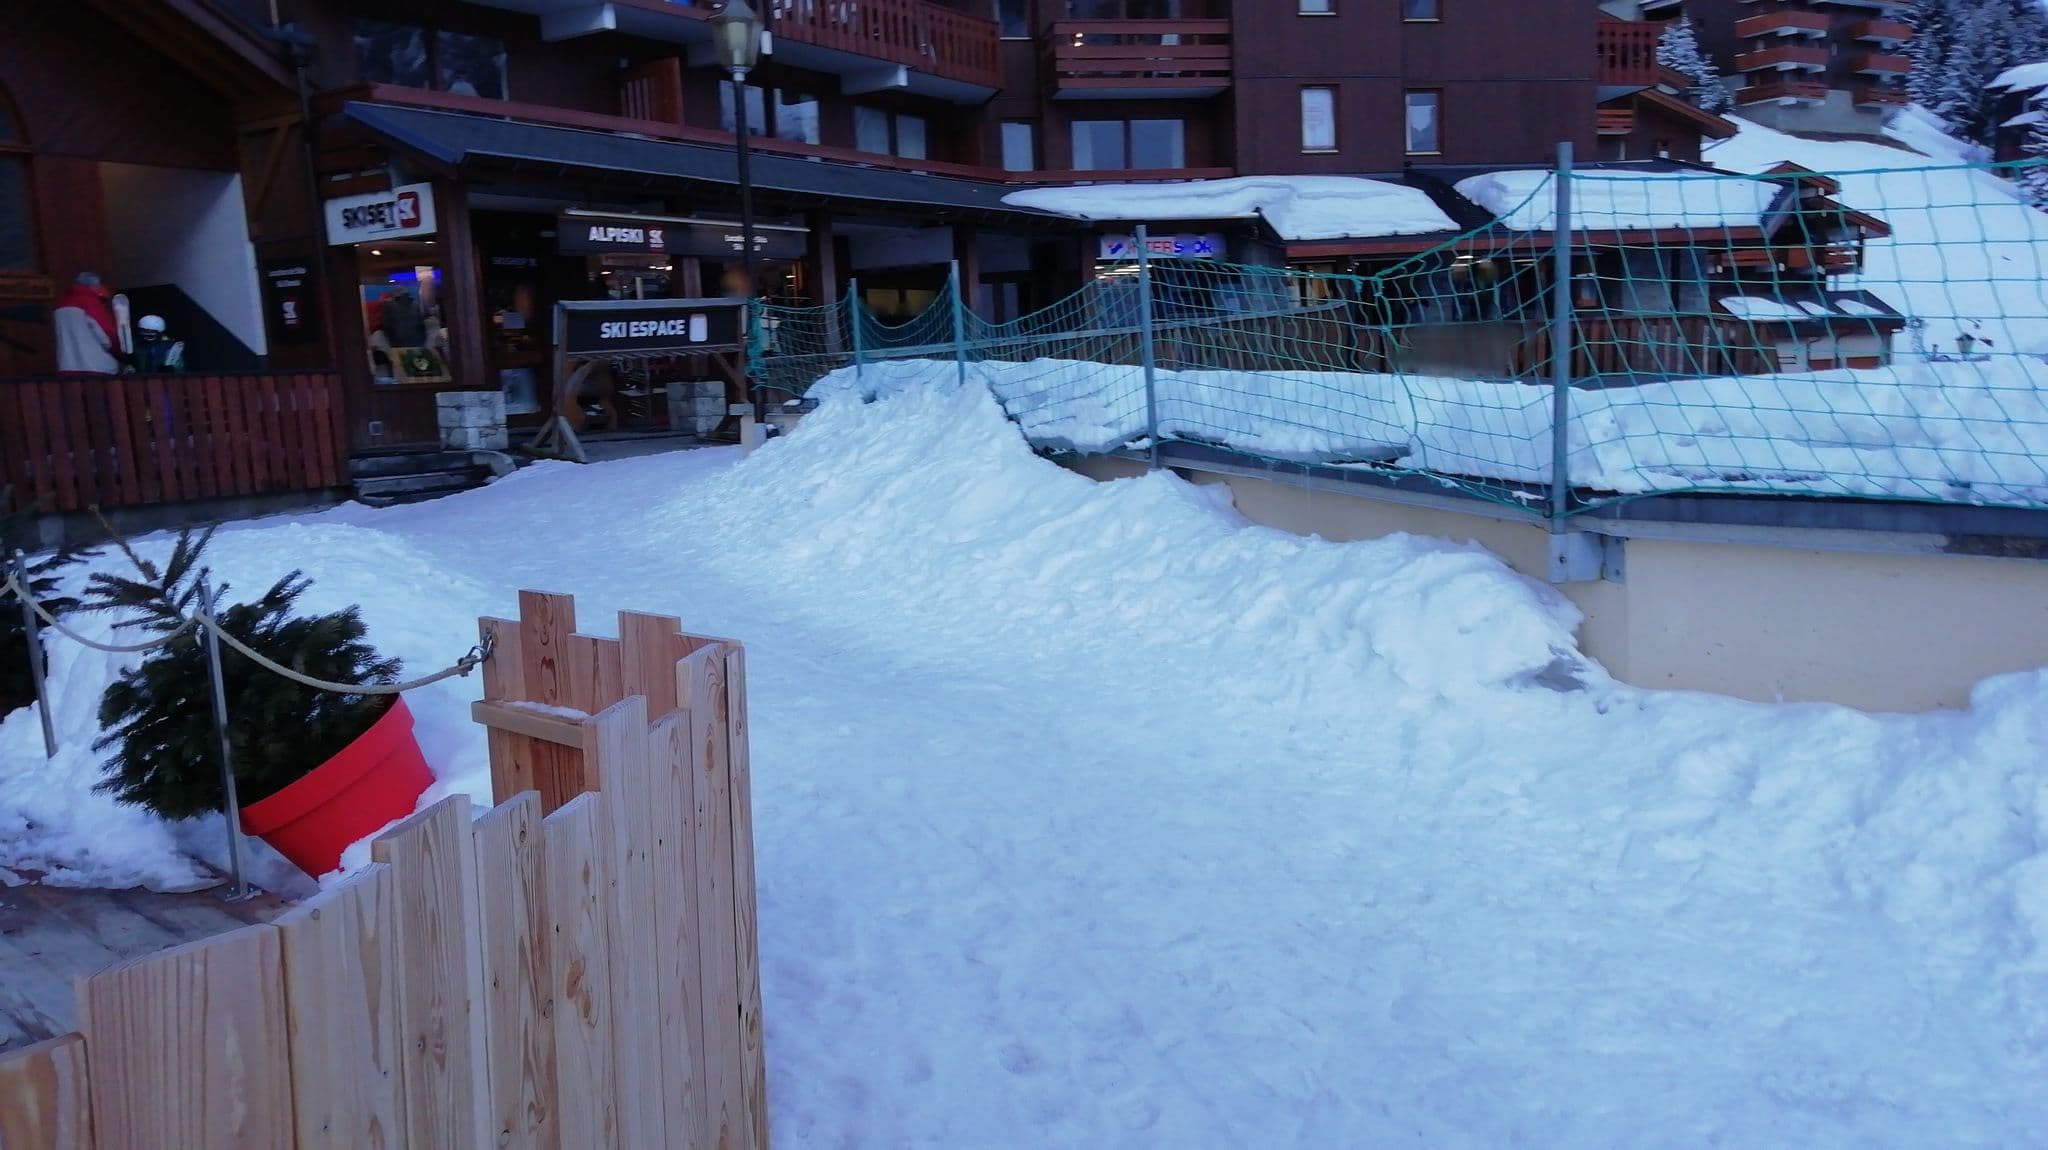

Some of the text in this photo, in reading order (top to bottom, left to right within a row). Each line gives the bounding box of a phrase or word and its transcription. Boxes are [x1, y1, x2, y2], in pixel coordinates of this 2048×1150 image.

[342, 201, 396, 230] SKISET
[589, 226, 644, 243] ALPISKI
[600, 319, 685, 339] SKI ESPACE
